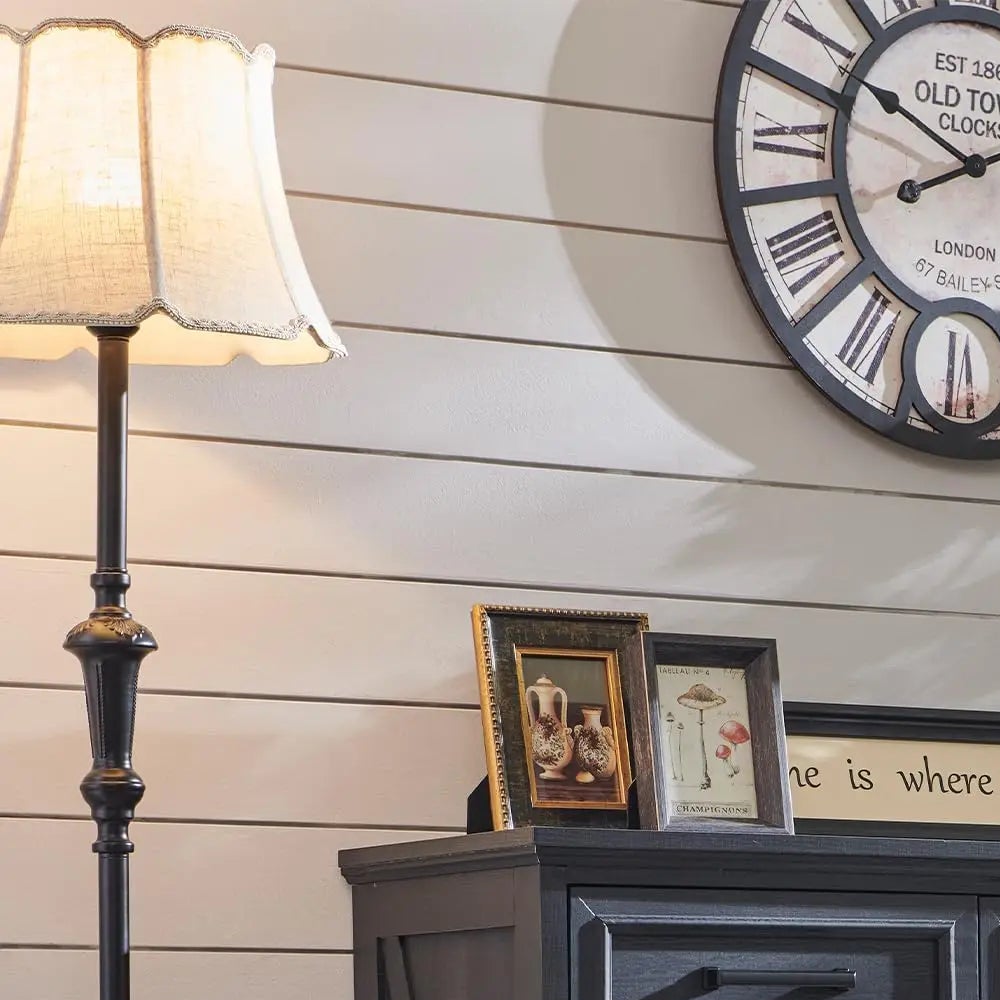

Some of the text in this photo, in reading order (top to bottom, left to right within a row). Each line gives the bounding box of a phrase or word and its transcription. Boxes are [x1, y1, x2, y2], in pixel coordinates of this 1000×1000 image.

[935, 52, 968, 74] EST
[915, 80, 960, 107] OLD
[934, 239, 996, 262] LONDON
[915, 258, 935, 276] 67
[936, 269, 989, 293] BAILEY
[847, 758, 874, 790] is
[897, 755, 994, 796] where
[676, 805, 748, 814] CHAMPIGNONS
